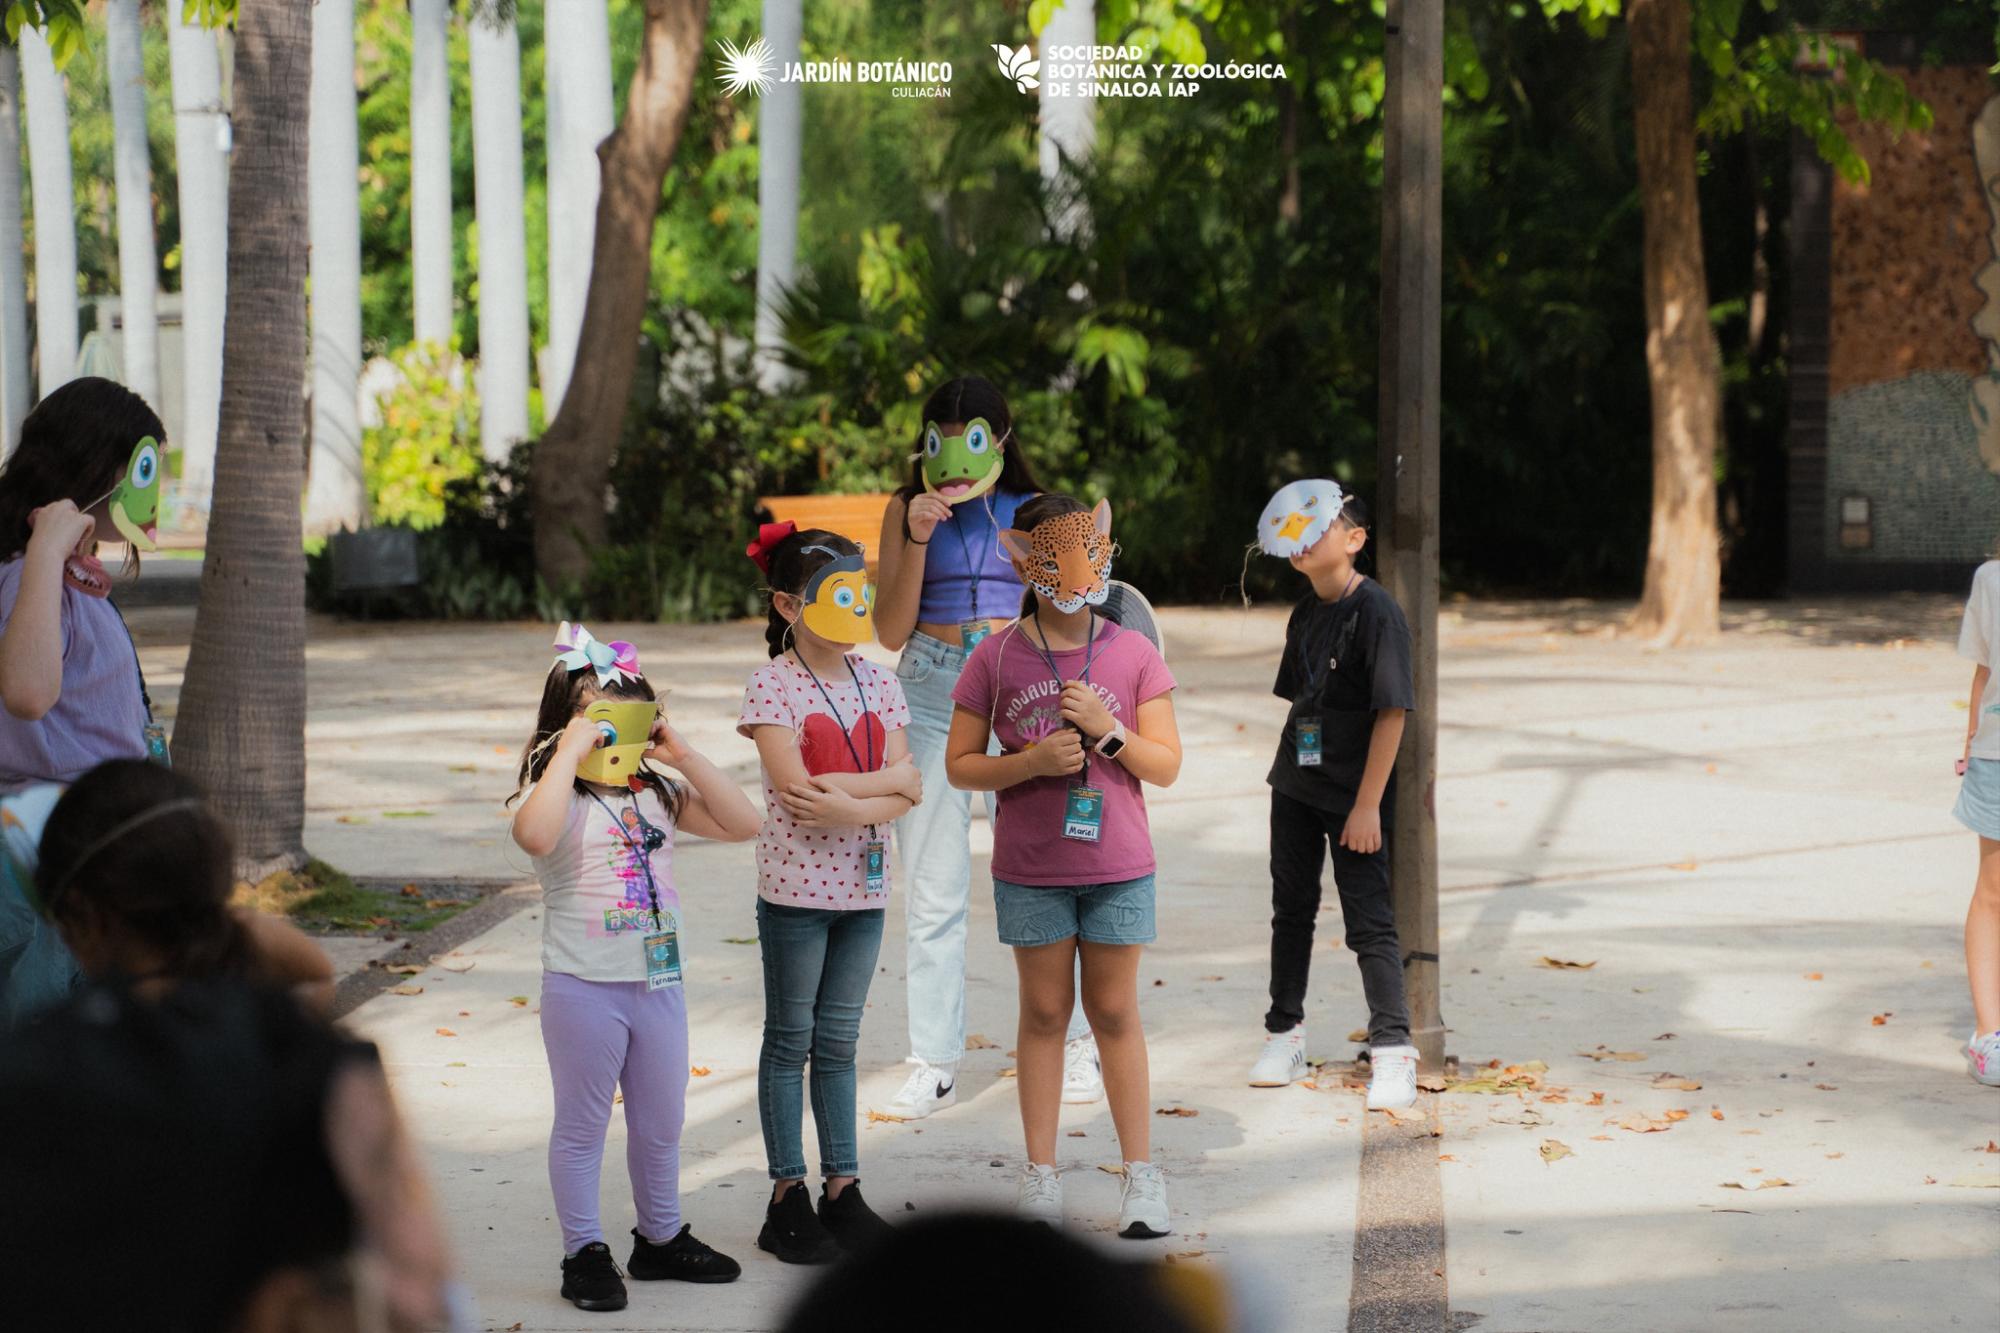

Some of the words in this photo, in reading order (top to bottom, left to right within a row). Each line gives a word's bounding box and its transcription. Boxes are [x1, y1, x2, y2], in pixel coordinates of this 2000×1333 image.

[1005, 680, 1059, 722] MOJAVE
[1066, 679, 1123, 716] SERT
[1069, 826, 1095, 837] Mariel
